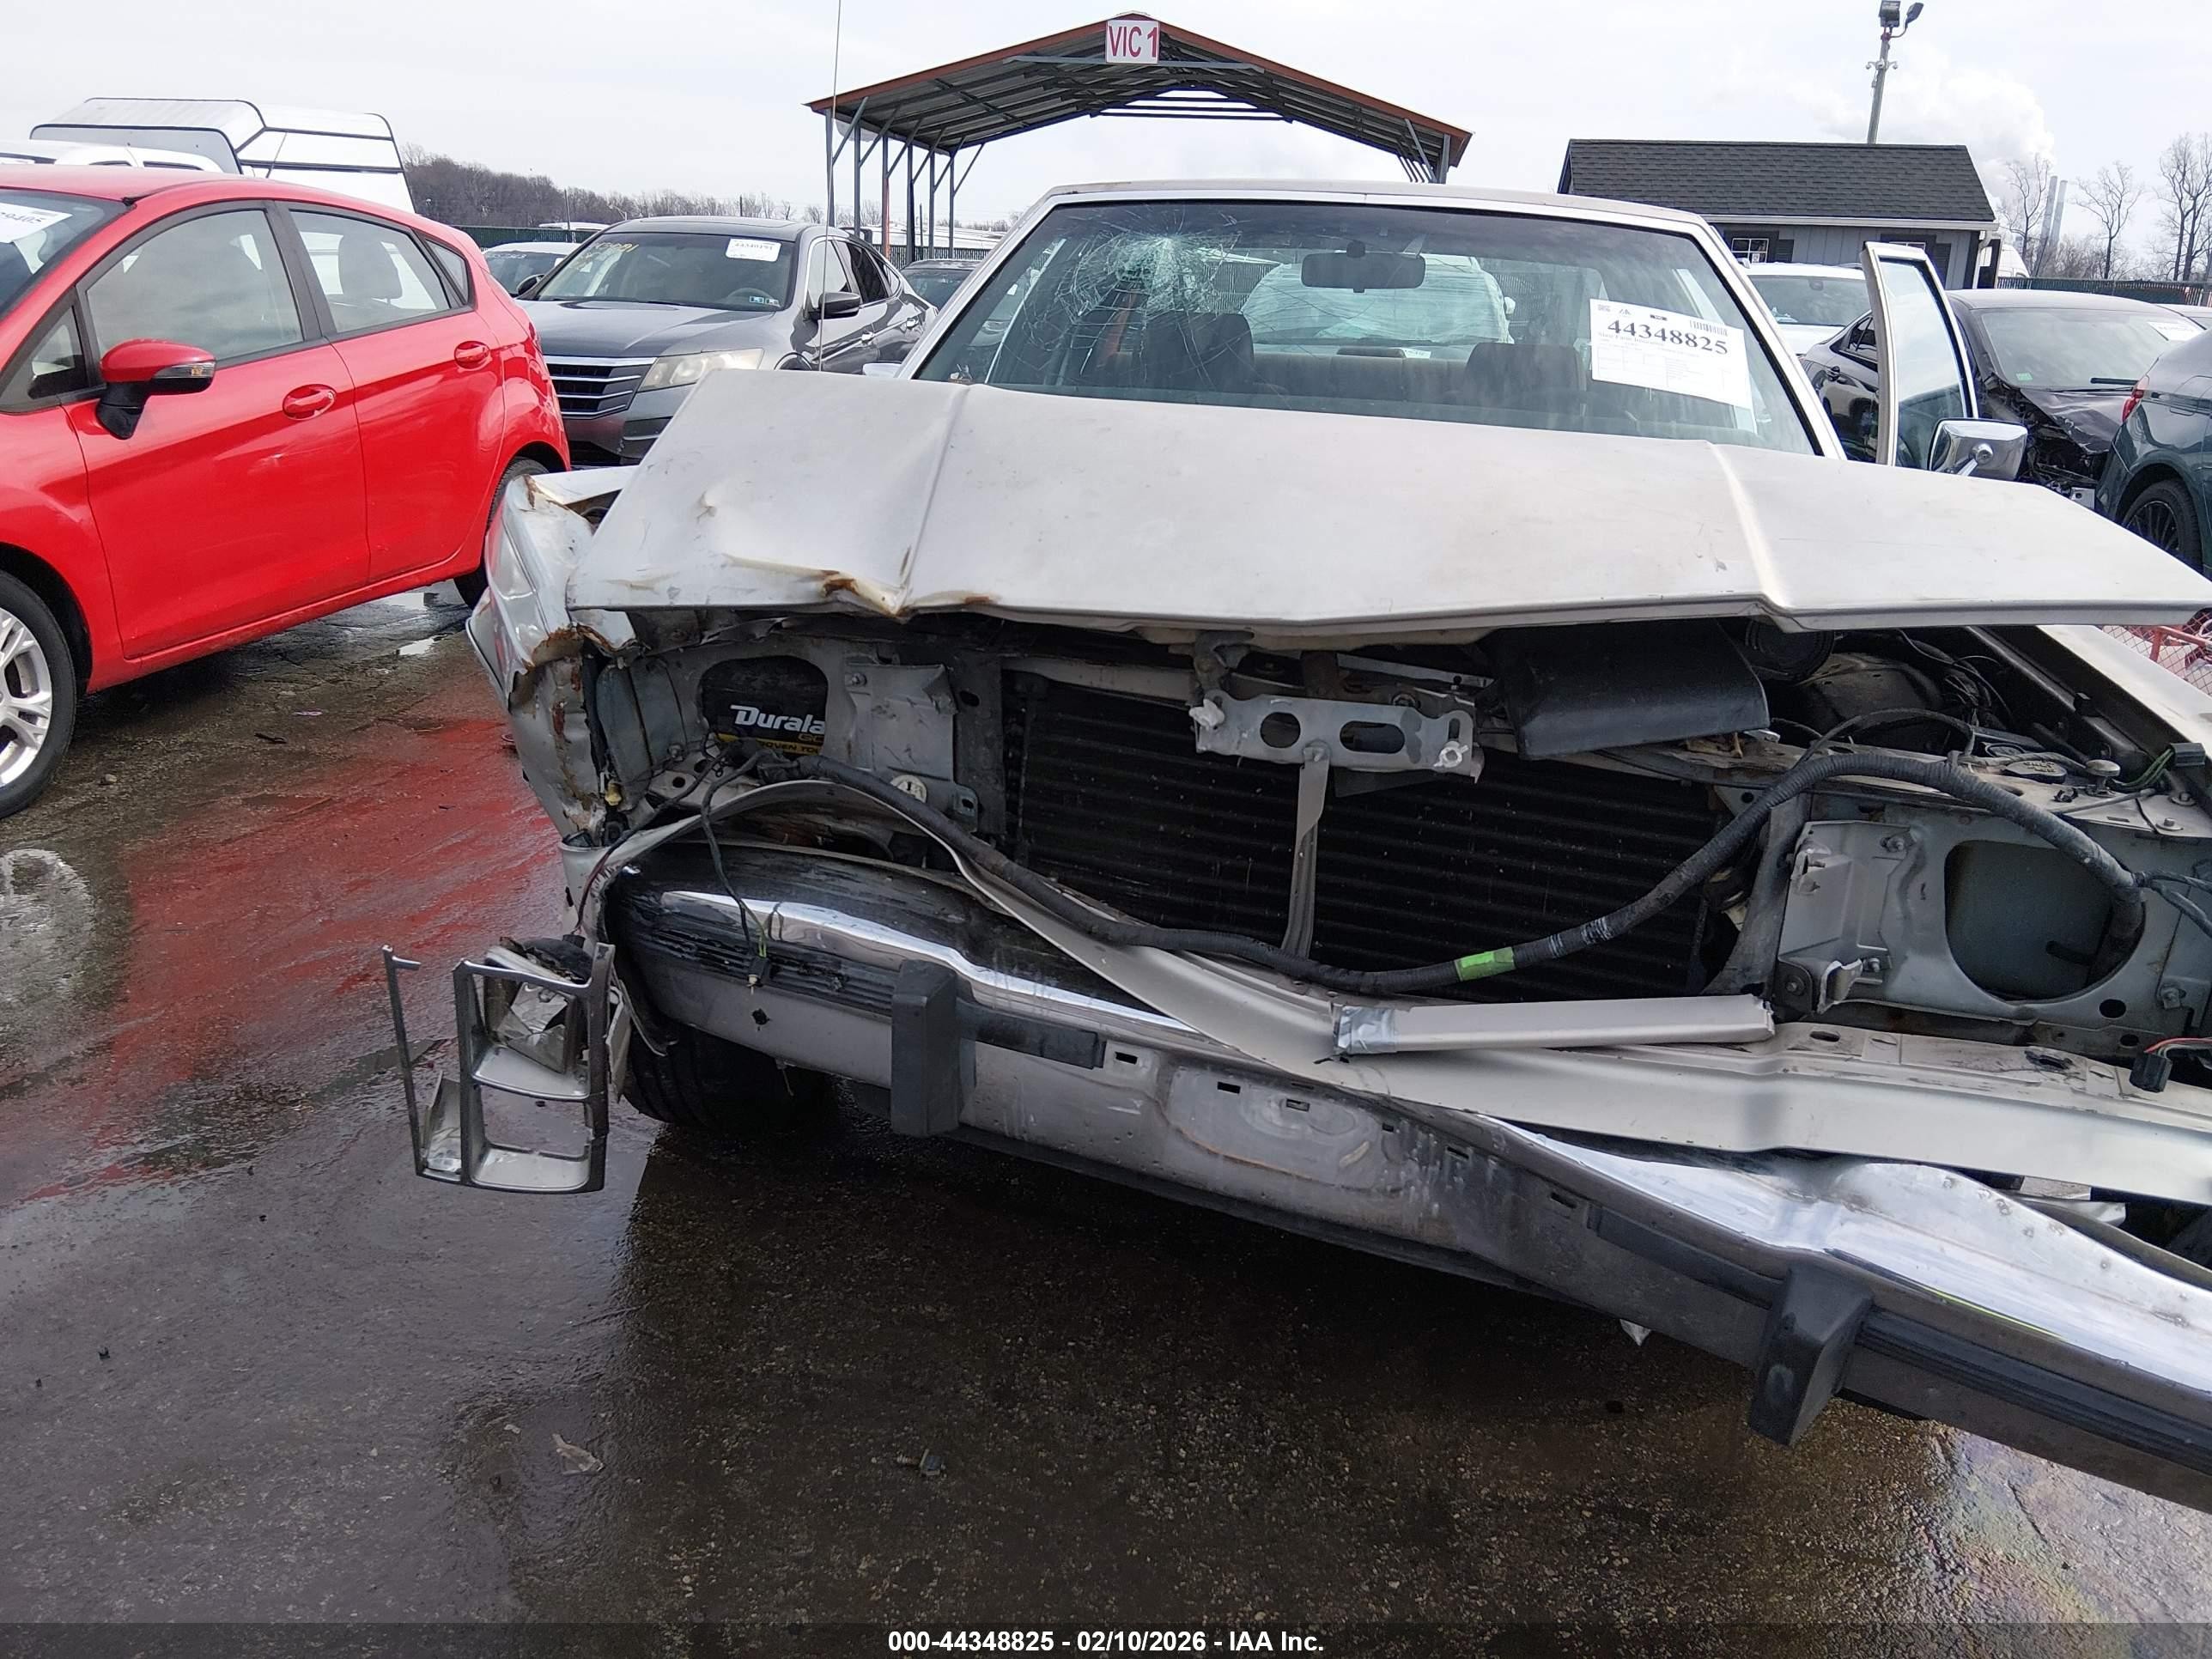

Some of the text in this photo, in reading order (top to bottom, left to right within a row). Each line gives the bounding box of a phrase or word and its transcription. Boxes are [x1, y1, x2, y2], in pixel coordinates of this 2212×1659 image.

[1108, 26, 1158, 58] VIC 1
[1607, 319, 1728, 355] 44348825
[730, 704, 825, 735] Durala
